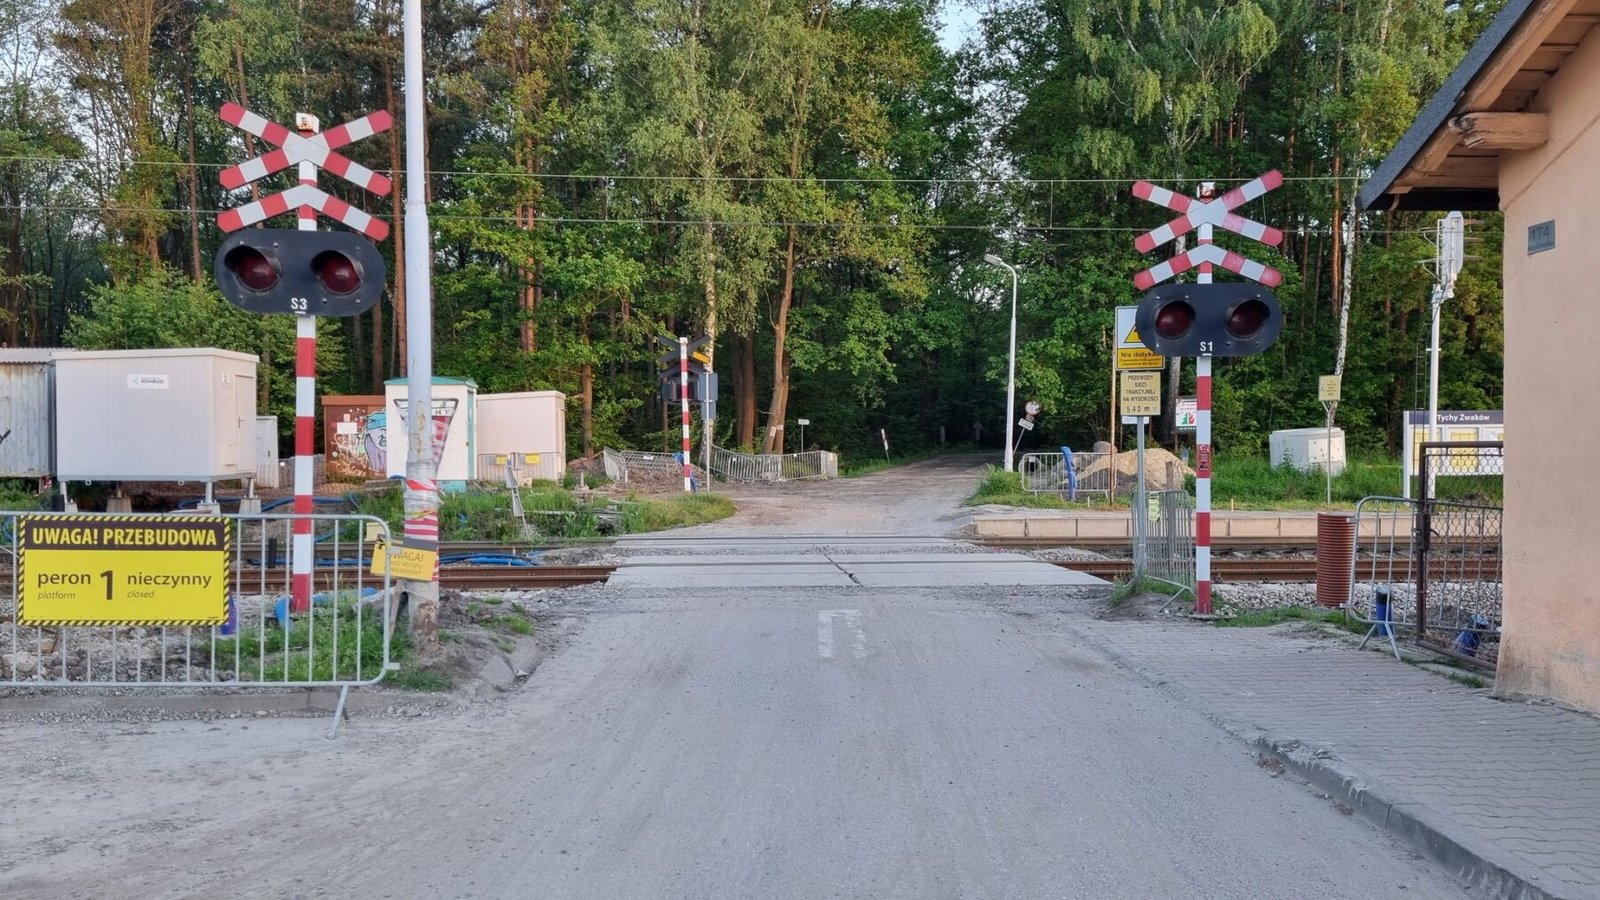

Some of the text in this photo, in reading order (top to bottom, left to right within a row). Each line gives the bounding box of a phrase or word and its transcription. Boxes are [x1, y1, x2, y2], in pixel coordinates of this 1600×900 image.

[290, 297, 307, 310] S3
[1200, 341, 1213, 352] S1
[1437, 412, 1490, 422] Tychy Żwaków
[32, 528, 217, 546] UWAGA! PRZEBUDOWA
[391, 552, 424, 561] WAGA!
[37, 570, 212, 600] peron 1 nieczynny
[37, 590, 155, 600] platform closed
